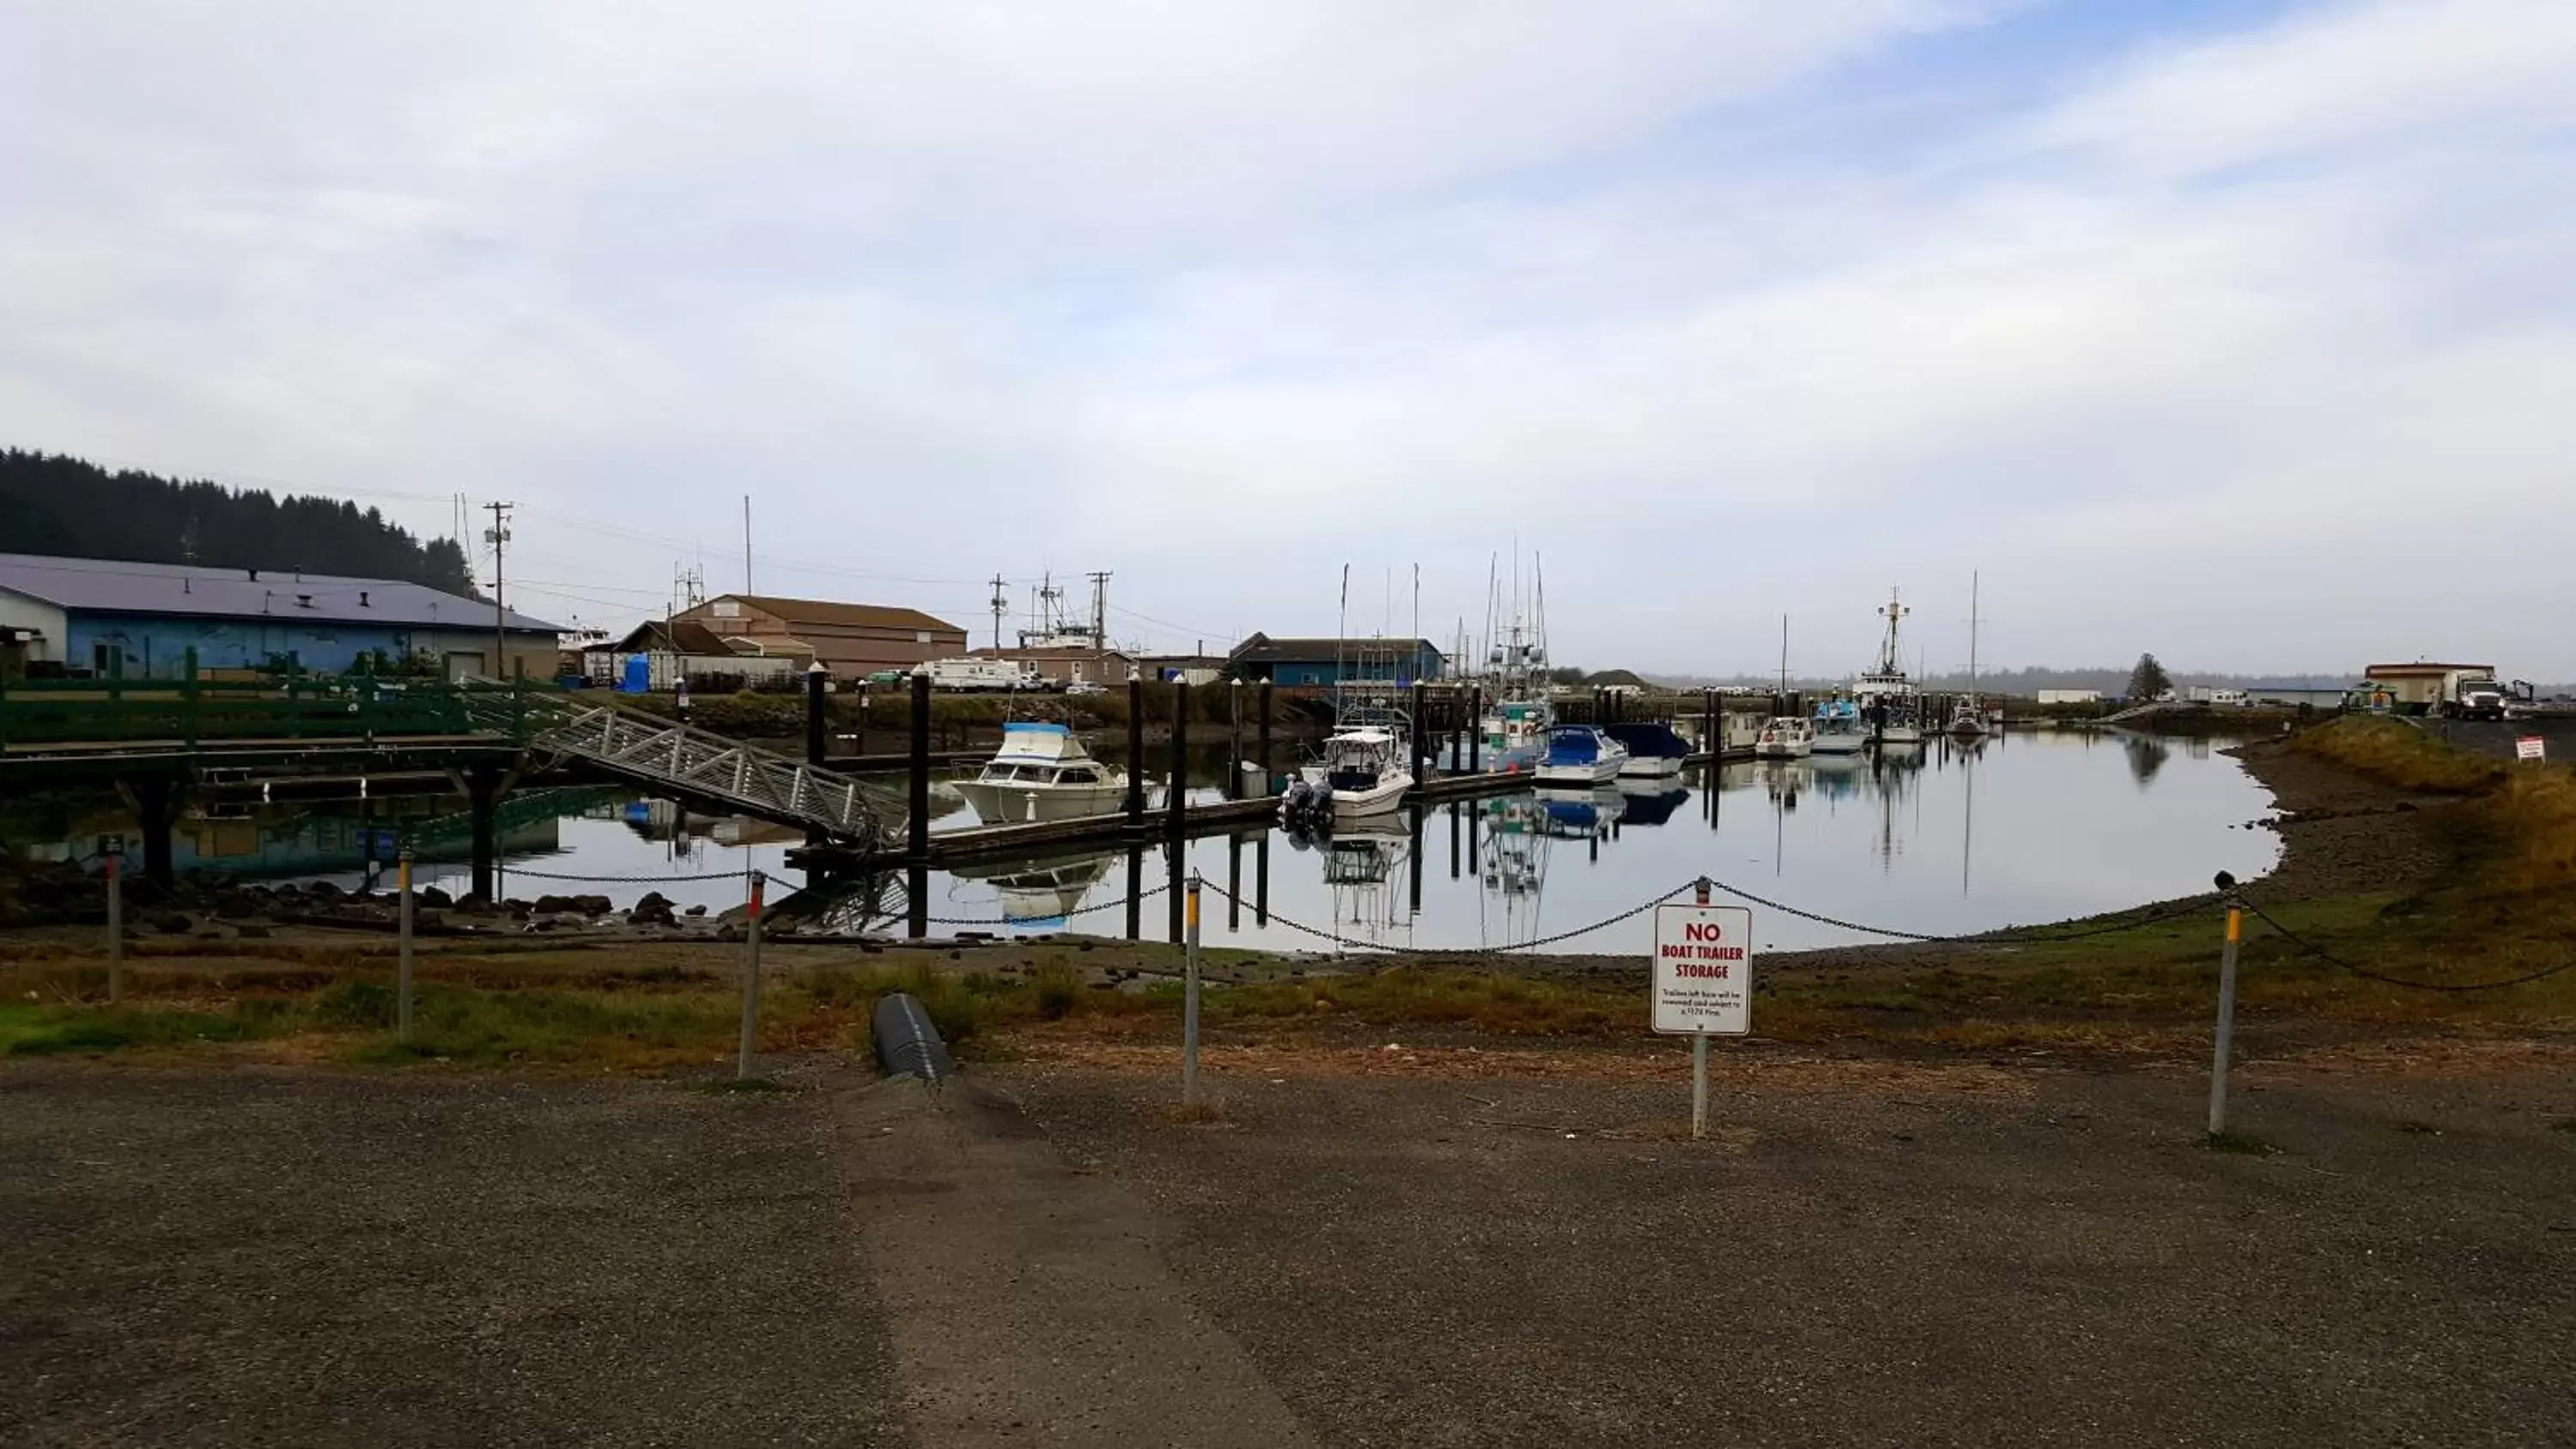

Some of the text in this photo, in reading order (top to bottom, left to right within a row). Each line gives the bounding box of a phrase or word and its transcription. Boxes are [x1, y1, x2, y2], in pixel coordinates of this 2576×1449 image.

[1686, 922, 1721, 942] NO
[1662, 944, 1744, 961] BOAT TRAILER
[1675, 964, 1728, 979] STORAGE
